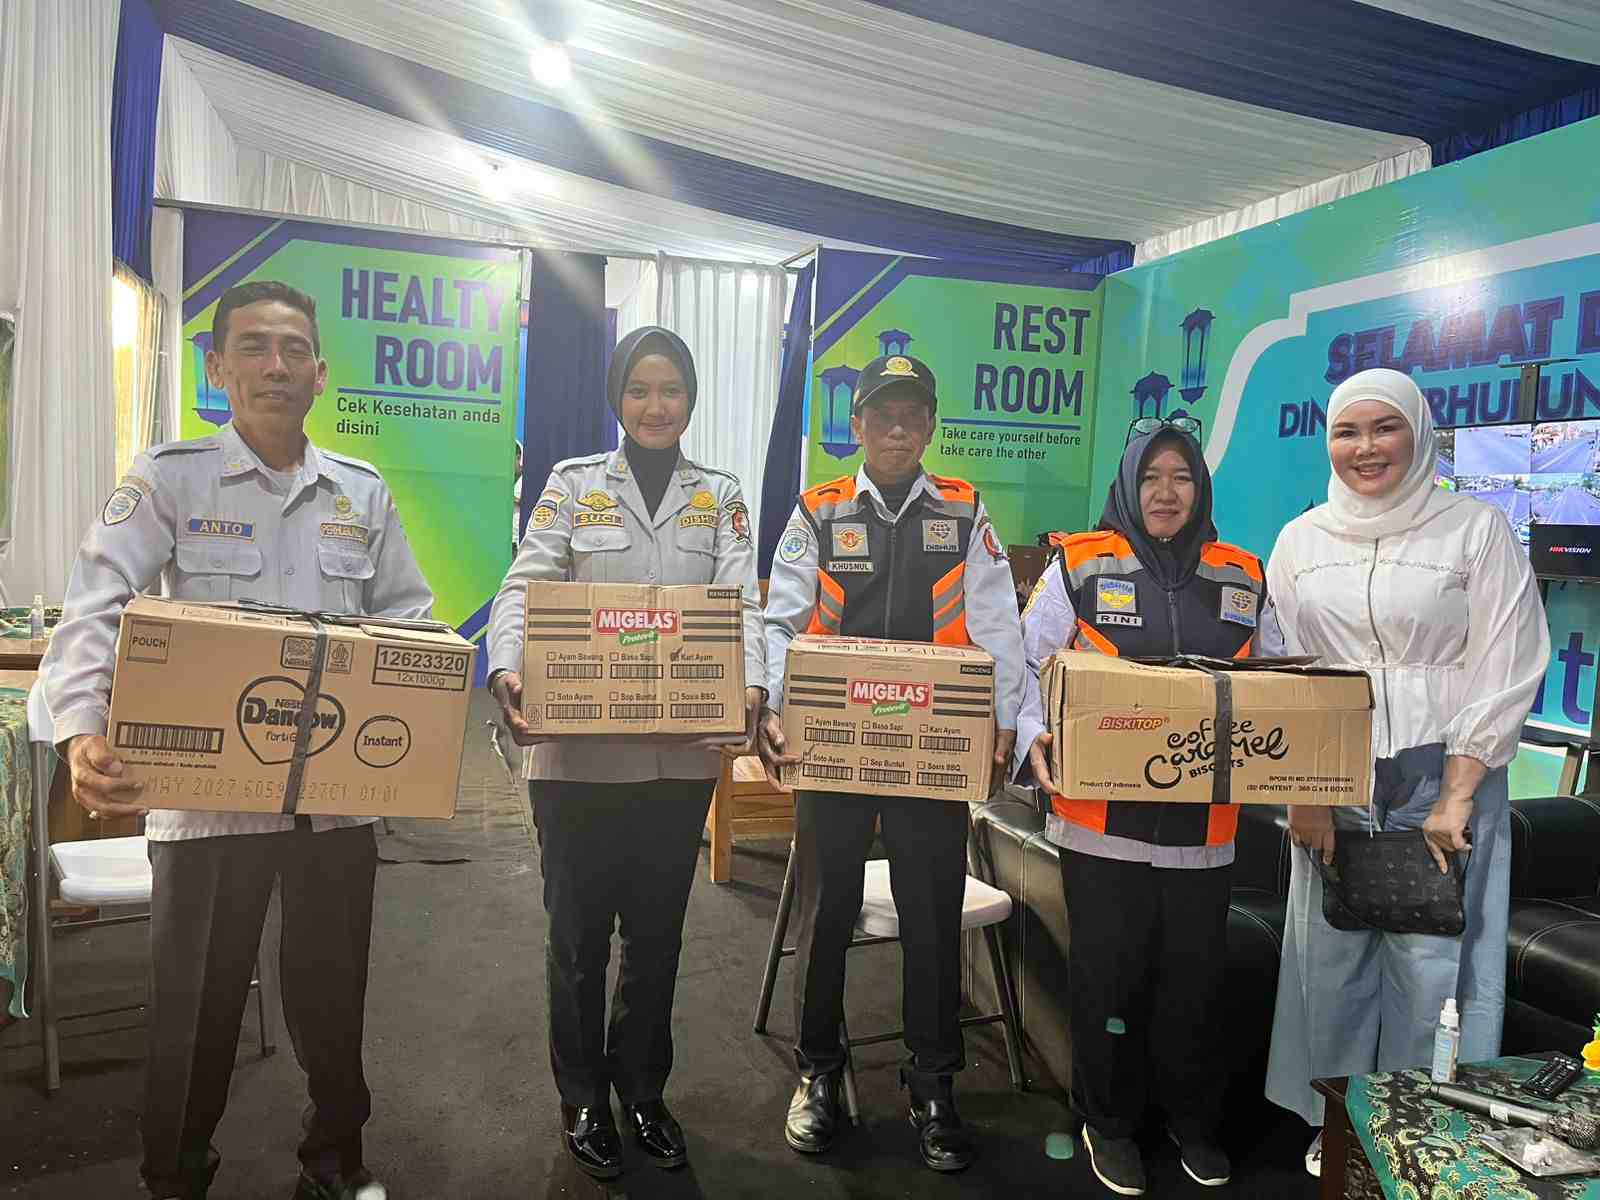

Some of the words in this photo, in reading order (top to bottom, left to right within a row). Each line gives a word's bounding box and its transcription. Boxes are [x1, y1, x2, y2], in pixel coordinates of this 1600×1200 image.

[342, 268, 503, 332] HEALTY
[993, 302, 1091, 356] REST
[375, 335, 501, 392] ROOM
[974, 364, 1084, 416] ROOM
[337, 396, 367, 413] Cek
[373, 400, 457, 421] Kesehatan
[462, 406, 500, 423] anda
[1279, 398, 1327, 438] DIN
[336, 418, 380, 436] disini
[941, 427, 967, 440] Take
[970, 430, 995, 441] care
[998, 430, 1043, 446] yourself
[1046, 432, 1081, 446] before
[940, 444, 965, 456] take
[968, 447, 993, 457] care
[996, 446, 1015, 458] the
[1017, 447, 1047, 460] other
[200, 520, 243, 535] ANTO
[832, 562, 869, 570] KHUSNUL
[598, 610, 674, 629] MIGELAS
[1101, 615, 1137, 624] RINI
[132, 636, 167, 649] POUCH
[380, 650, 465, 671] 12623320
[853, 682, 926, 702] MIGELAS
[1101, 717, 1162, 729] BISKITOP
[363, 735, 402, 748] Instant
[1167, 718, 1255, 749] cofee
[1189, 757, 1244, 778] BISCTS
